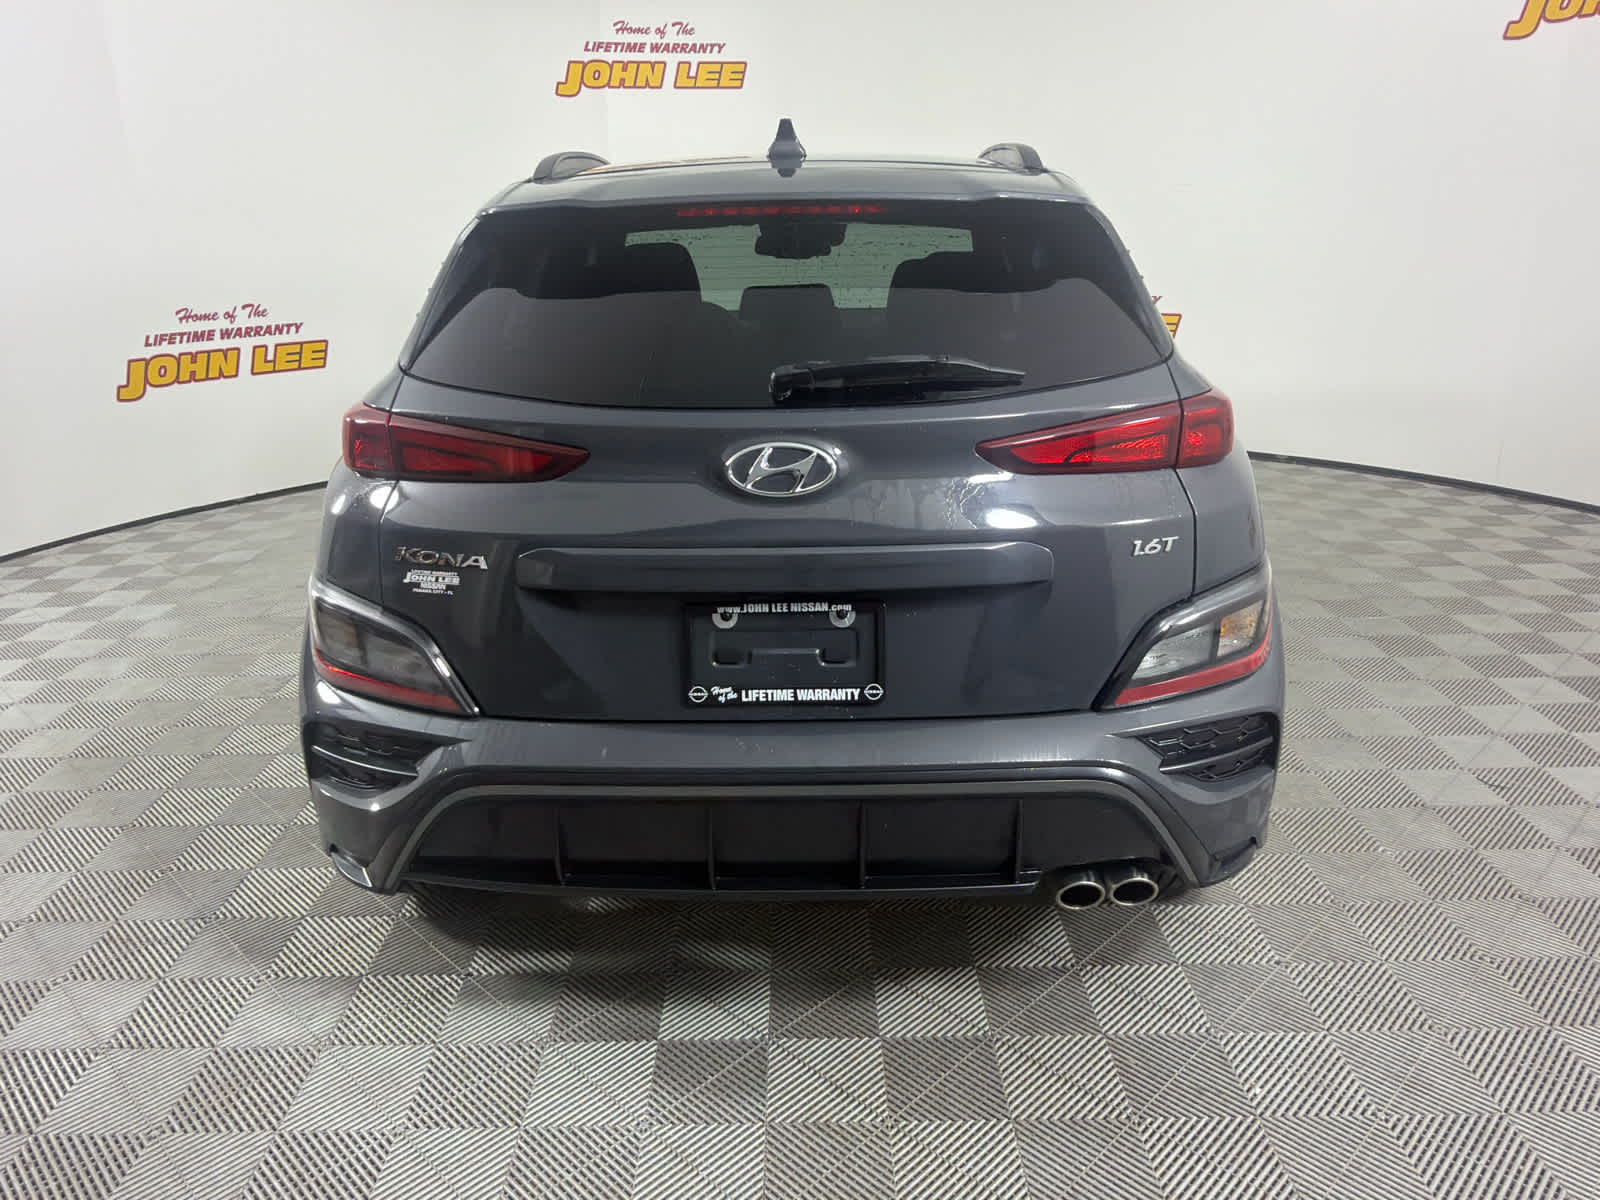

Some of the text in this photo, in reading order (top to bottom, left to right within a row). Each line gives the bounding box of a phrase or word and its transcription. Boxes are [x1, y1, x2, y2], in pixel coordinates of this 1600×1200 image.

[612, 20, 696, 39] Home of The
[1502, 0, 1600, 41] JO
[583, 41, 727, 55] LIFETIME WARRANTY
[555, 59, 748, 98] JOHN LEE
[175, 303, 269, 325] Home of The
[143, 322, 304, 348] LIFETIME WARRANTY
[116, 339, 329, 403] JOHN LEE
[394, 546, 488, 569] KONA
[402, 571, 461, 586] JOHN LEE
[771, 602, 789, 613] LEE
[741, 688, 861, 702] LIFETIME WARRANTY
